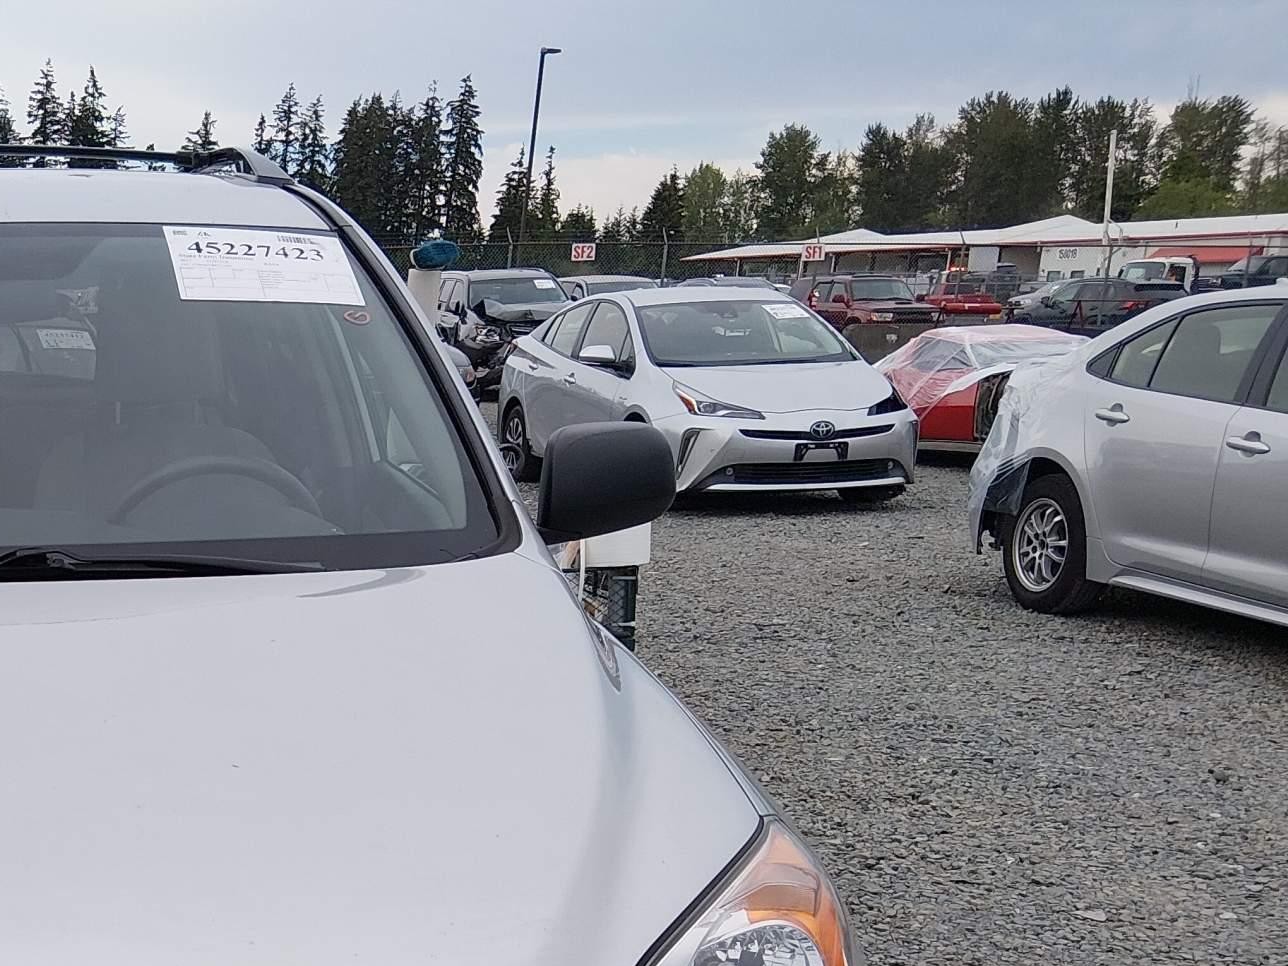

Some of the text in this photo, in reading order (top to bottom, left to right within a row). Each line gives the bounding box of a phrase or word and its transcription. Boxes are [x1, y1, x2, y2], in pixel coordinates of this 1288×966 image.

[187, 241, 325, 262] 45227423
[572, 245, 594, 259] SF2
[804, 246, 823, 260] SF1
